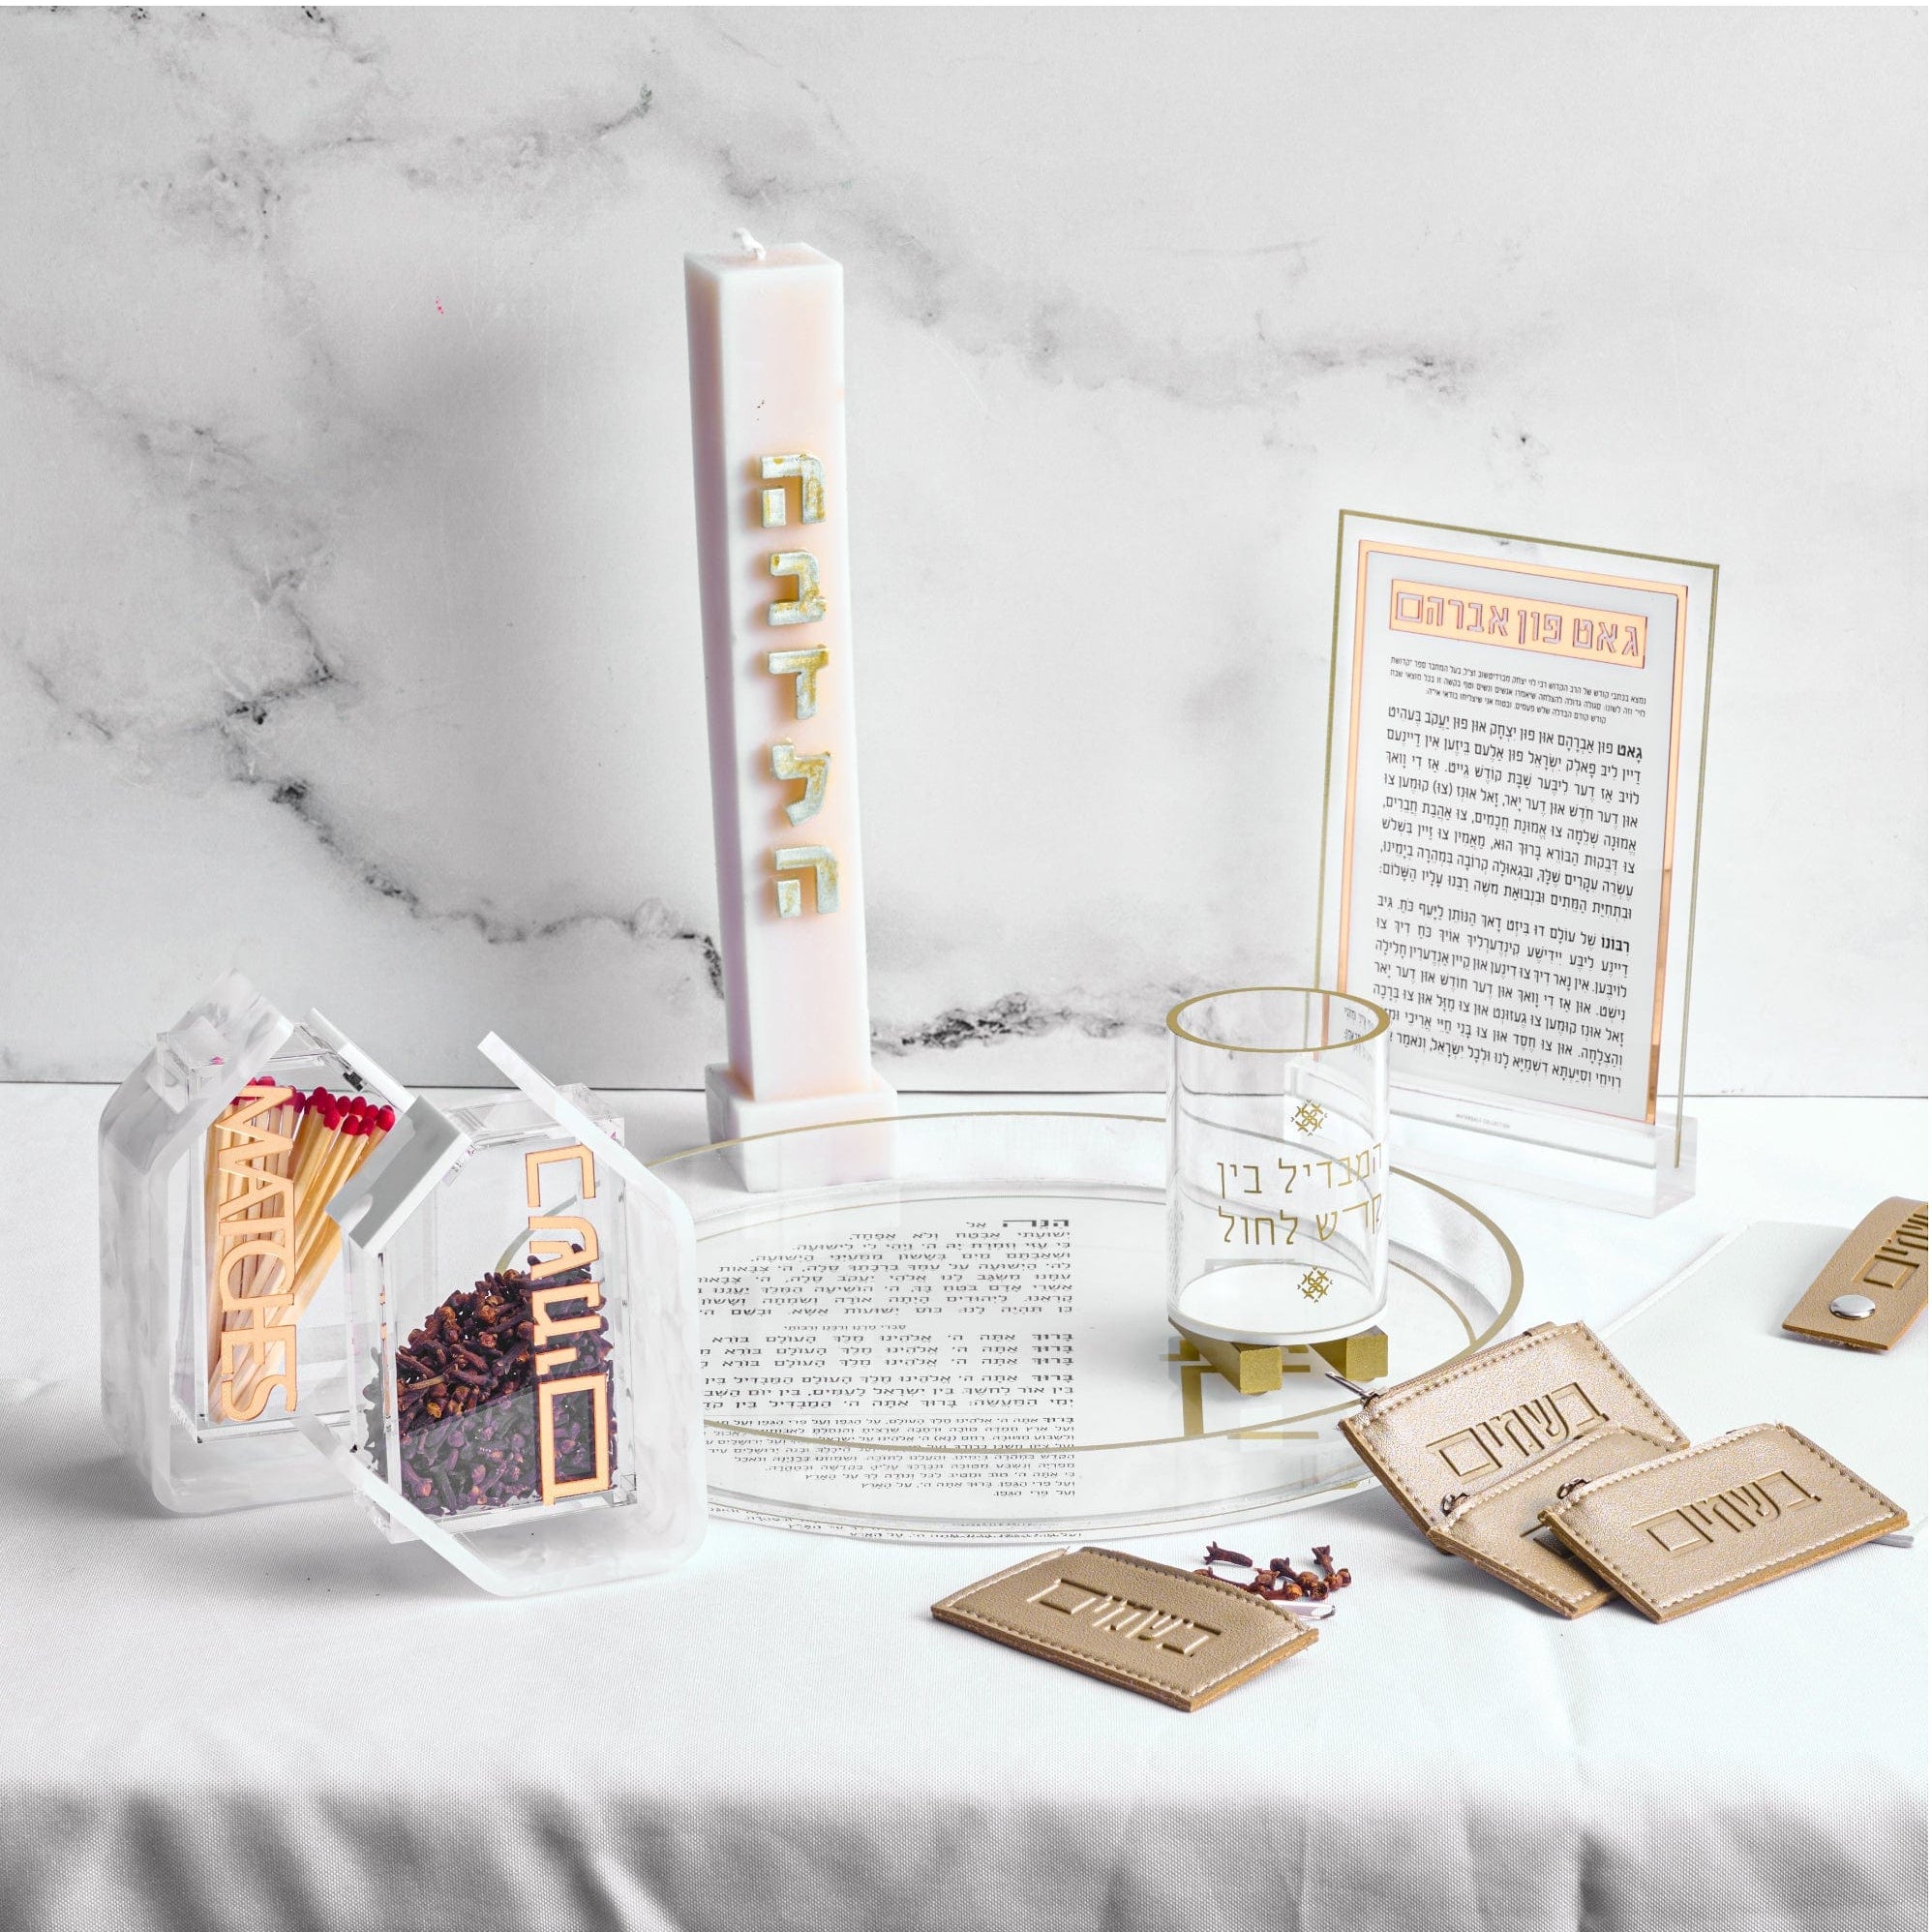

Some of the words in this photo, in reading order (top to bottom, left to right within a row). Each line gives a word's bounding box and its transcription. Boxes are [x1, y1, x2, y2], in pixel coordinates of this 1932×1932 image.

[1395, 590, 1510, 637] אברהם
[1517, 609, 1563, 644] פון
[1573, 618, 1640, 657] גאט
[760, 452, 841, 919] הבדלה
[1217, 1162, 1262, 1199] בין
[1279, 1142, 1382, 1193] המבדיל
[216, 1084, 298, 1422] MATCHES
[1219, 1205, 1298, 1246] לחול
[525, 1143, 613, 1507] בשמים
[1426, 1381, 1610, 1485] בשמים
[1631, 1469, 1823, 1554] בשמים
[1026, 1577, 1222, 1657] בשמים
